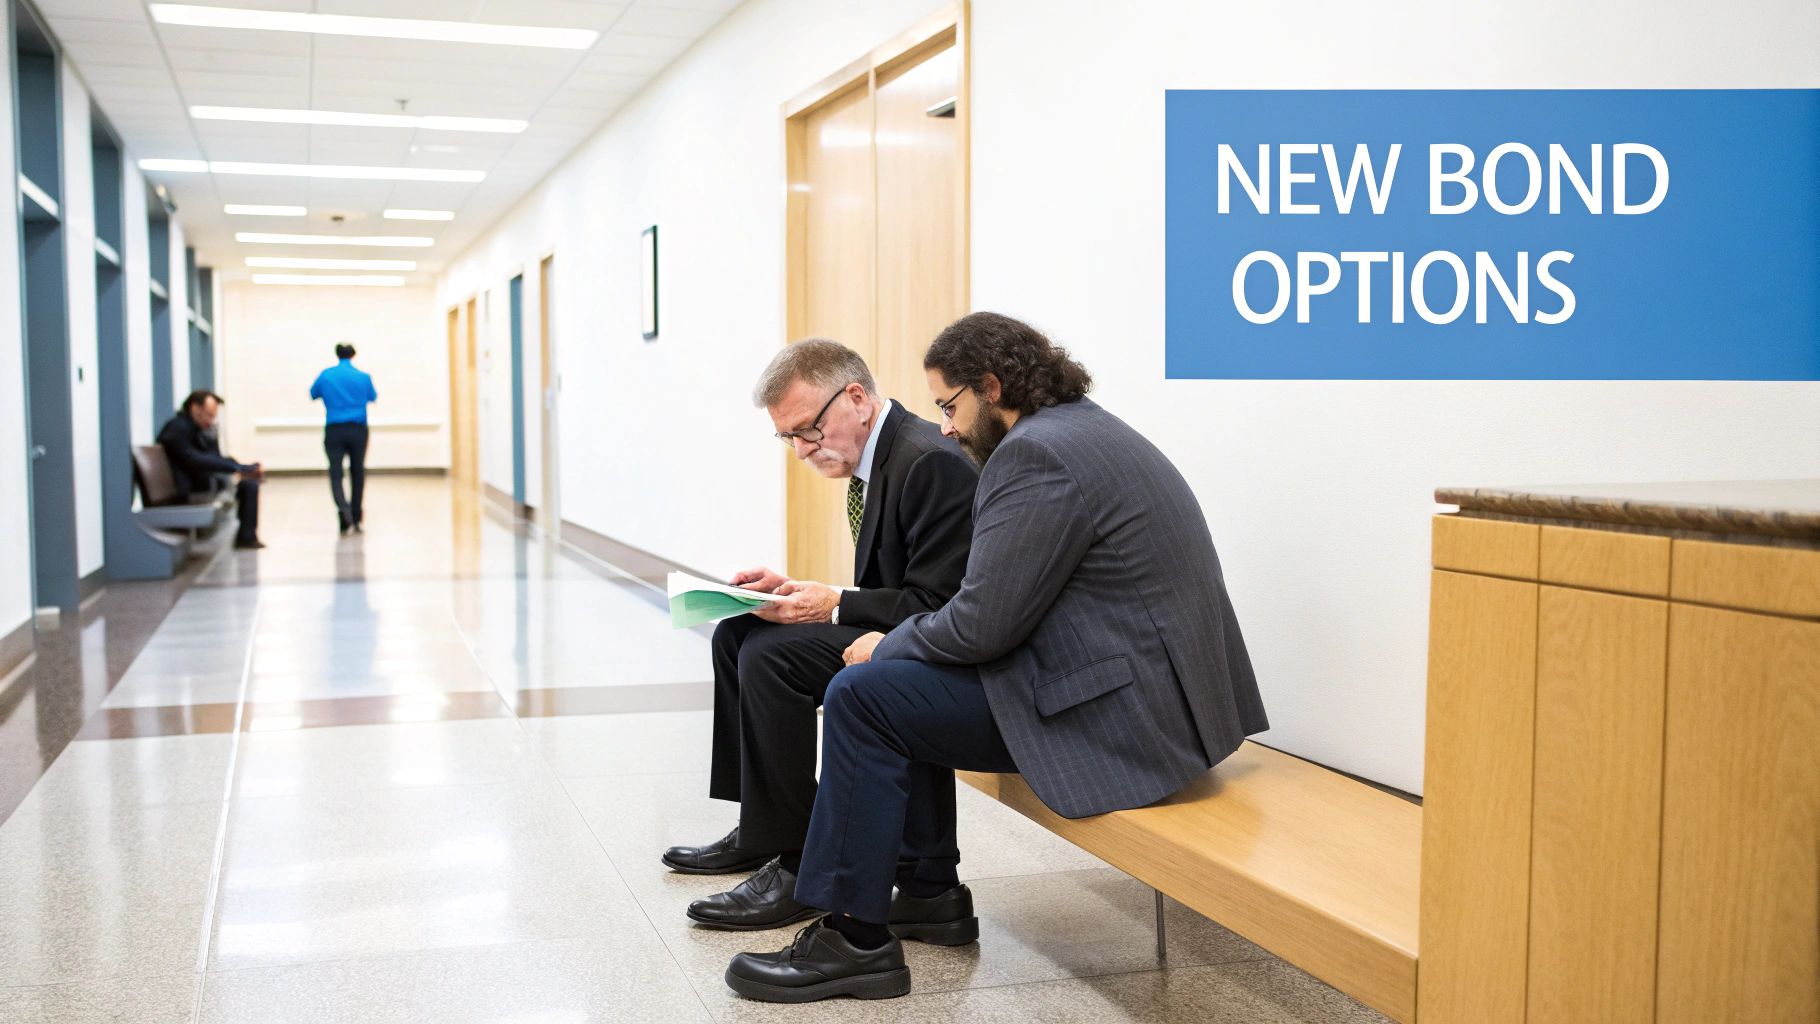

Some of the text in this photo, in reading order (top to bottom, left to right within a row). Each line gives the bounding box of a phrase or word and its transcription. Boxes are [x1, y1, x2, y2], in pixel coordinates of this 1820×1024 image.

[1217, 142, 1670, 215] NEW BOND
[1232, 250, 1576, 325] OPTIONS
